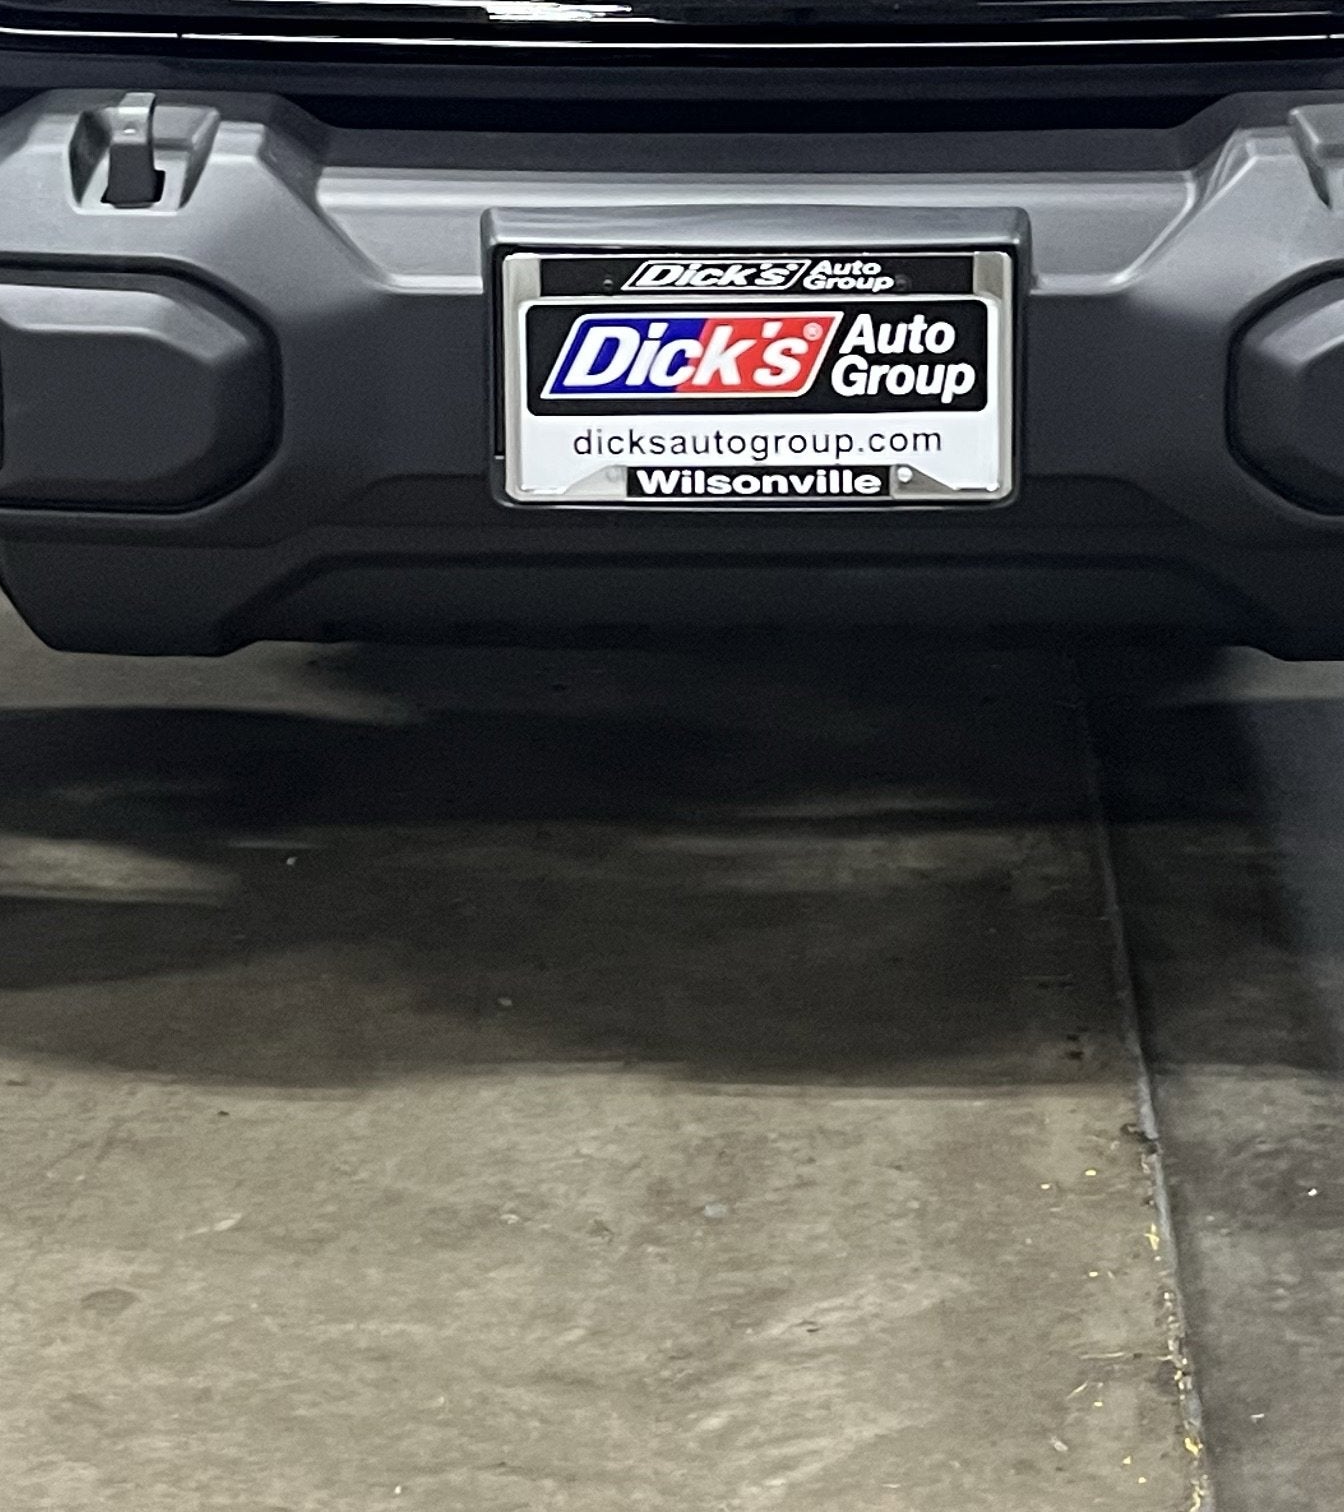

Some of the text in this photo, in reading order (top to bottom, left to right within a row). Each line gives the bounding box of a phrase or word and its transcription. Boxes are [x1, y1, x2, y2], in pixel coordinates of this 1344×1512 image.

[809, 259, 882, 276] Auto
[803, 273, 895, 293] Group
[839, 313, 955, 354] Auto
[830, 355, 976, 404] Group
[573, 428, 942, 461] dicksautogroup.com
[636, 468, 883, 496] Wilsonville
